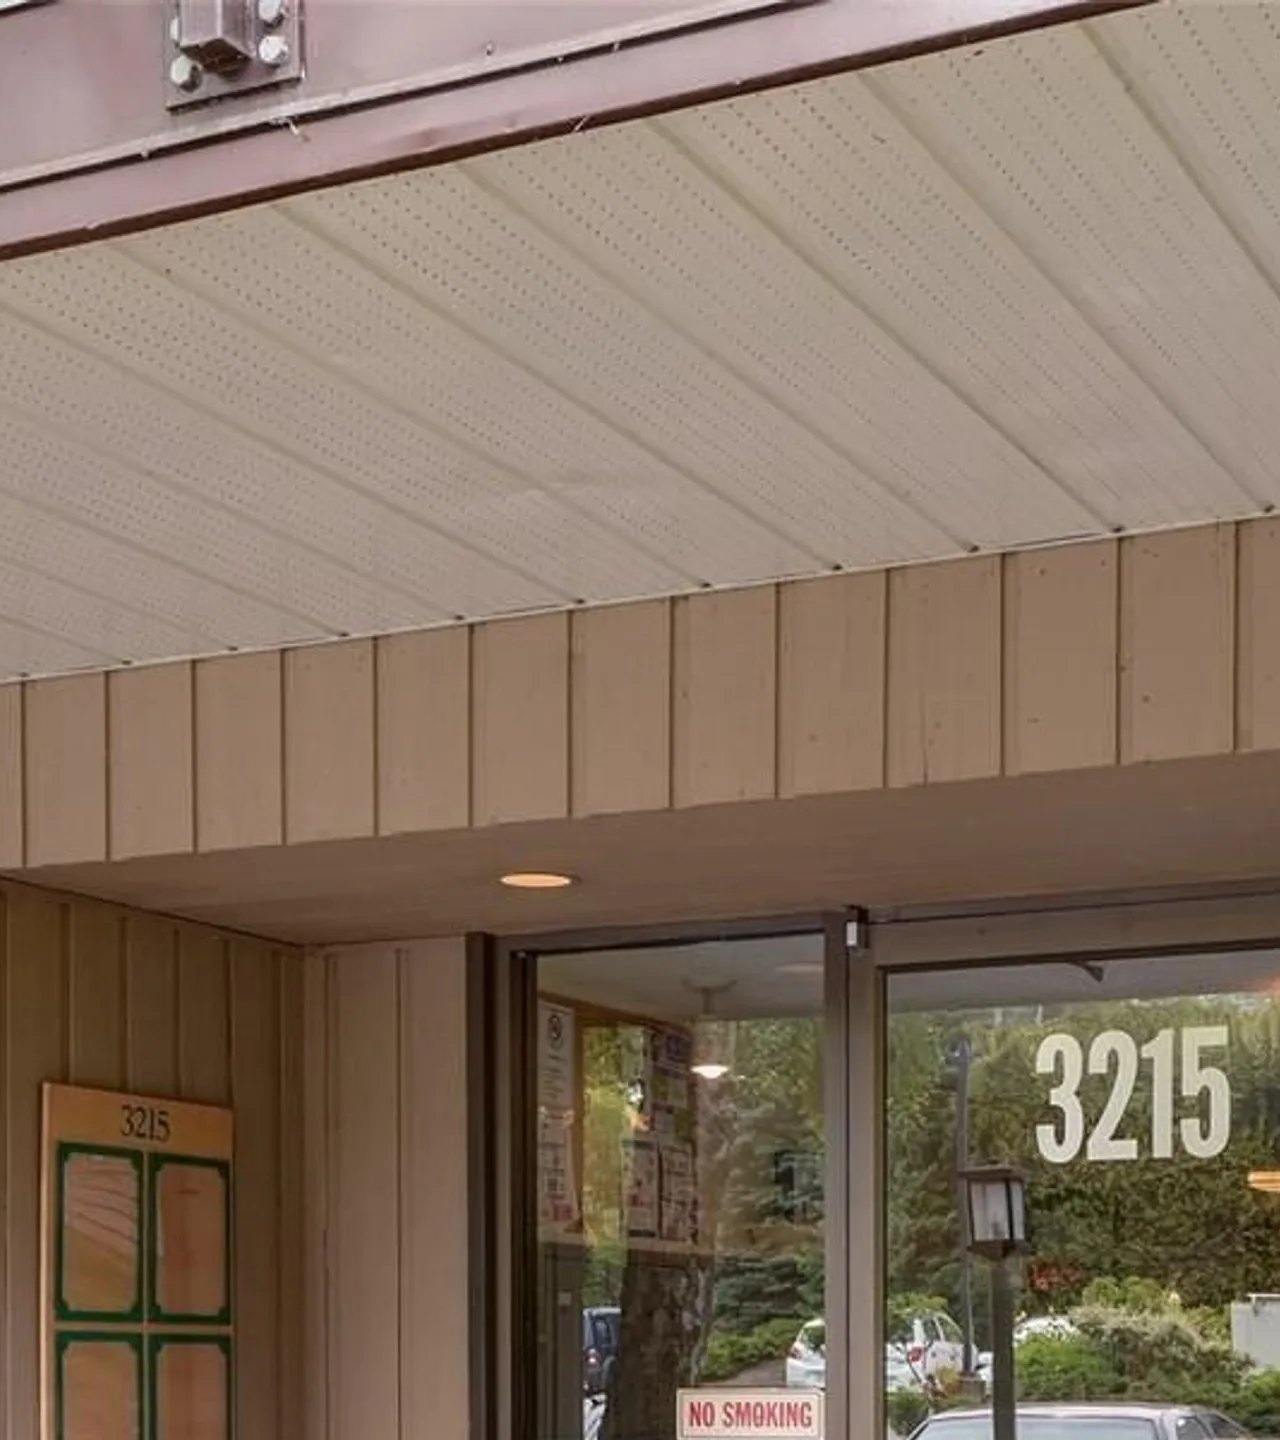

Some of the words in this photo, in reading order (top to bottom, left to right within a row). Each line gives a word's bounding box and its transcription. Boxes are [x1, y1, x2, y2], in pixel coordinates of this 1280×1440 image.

[1035, 1026, 1231, 1164] 3215
[121, 1104, 171, 1142] 3215
[689, 1402, 715, 1427] NO
[722, 1401, 812, 1428] SMOKING
